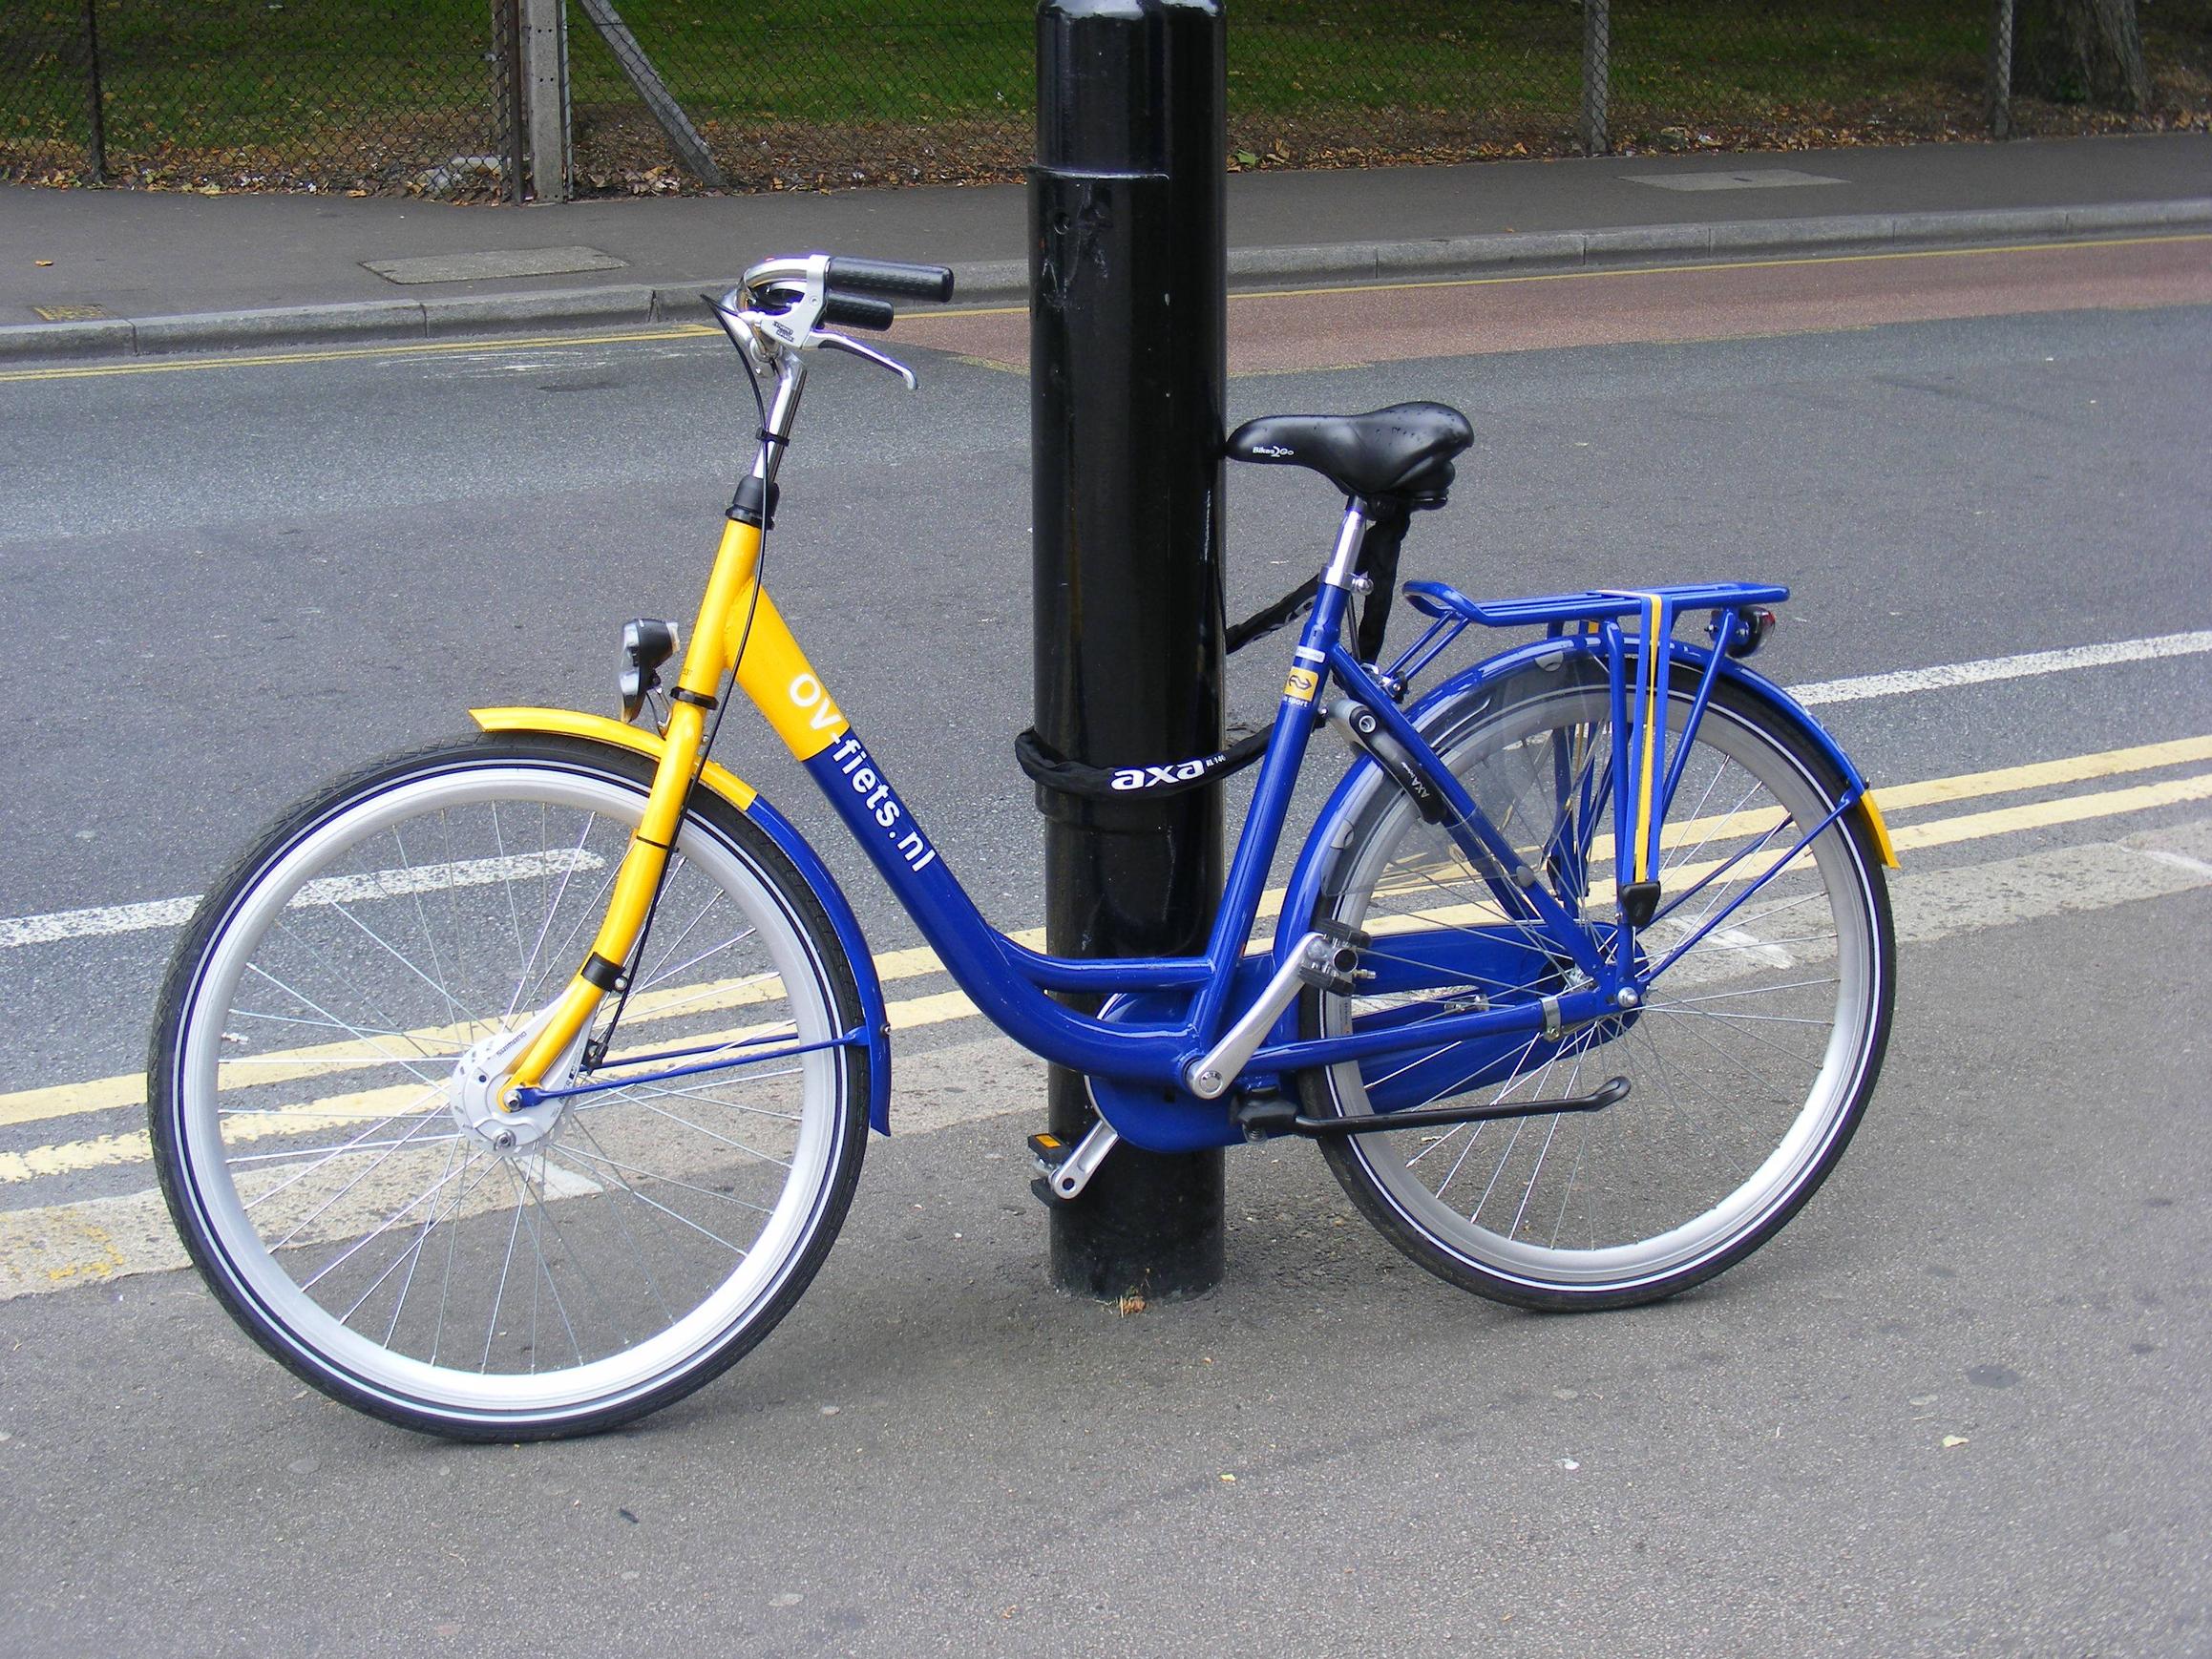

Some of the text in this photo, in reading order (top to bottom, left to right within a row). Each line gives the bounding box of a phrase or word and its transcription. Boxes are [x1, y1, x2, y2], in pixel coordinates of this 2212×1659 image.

[790, 673, 937, 872] OV-fiets.nl
[1111, 760, 1205, 790] axa
[1412, 777, 1430, 798] AXA
